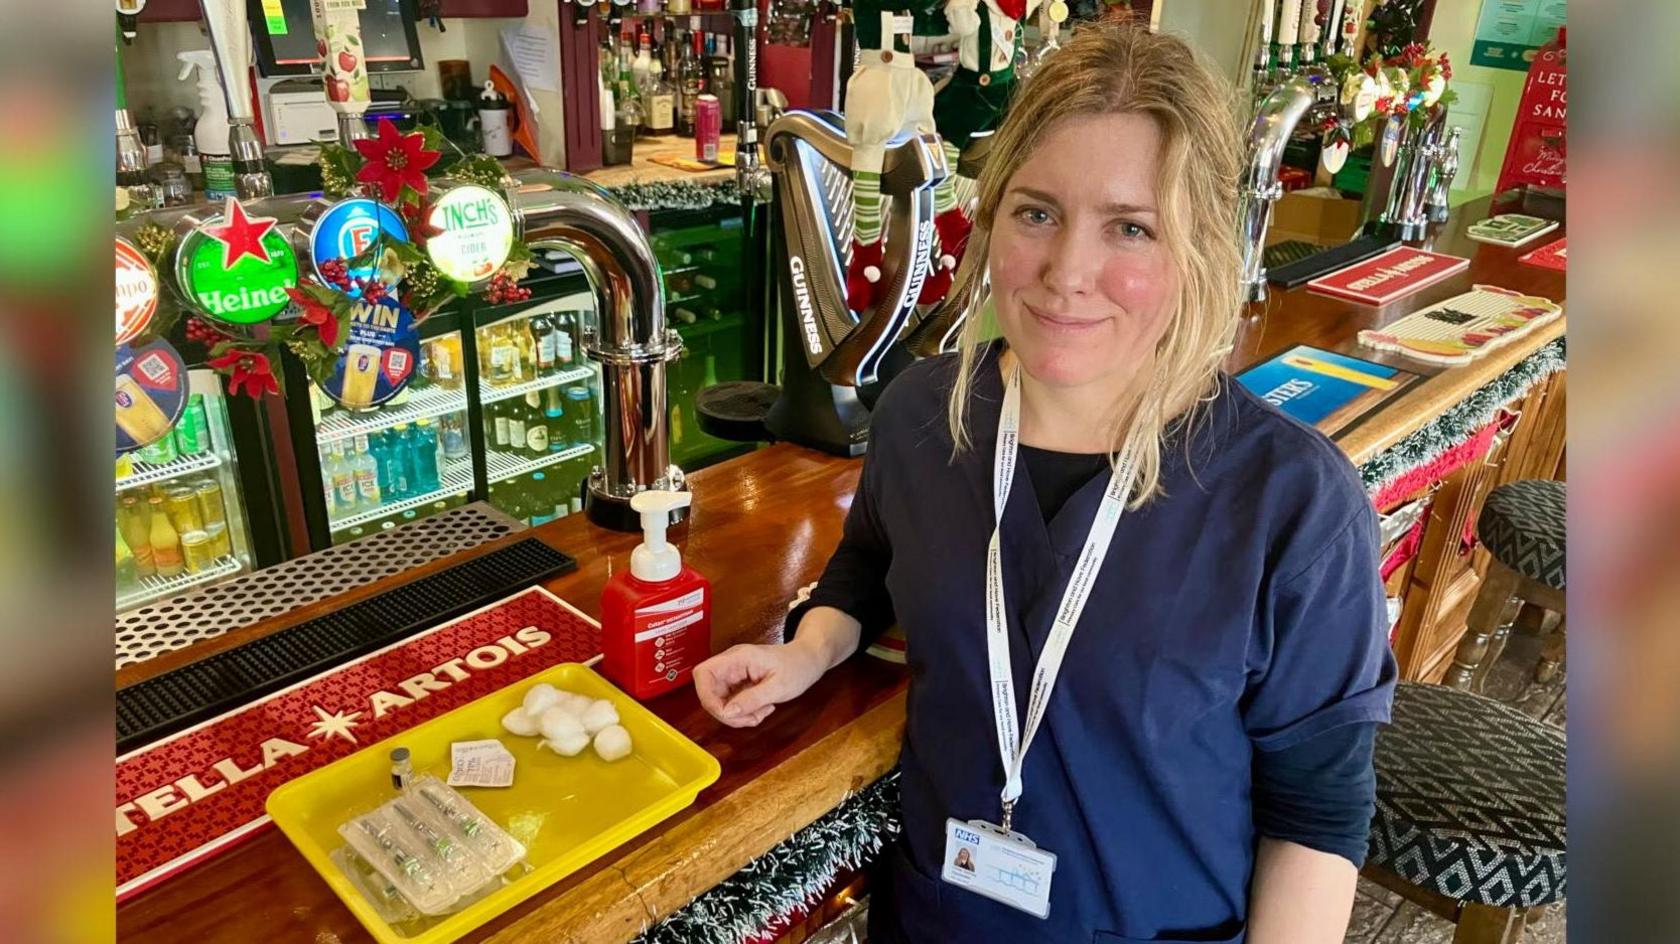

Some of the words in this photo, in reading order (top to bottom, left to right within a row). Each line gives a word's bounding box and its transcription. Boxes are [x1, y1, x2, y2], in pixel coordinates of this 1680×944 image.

[747, 38, 757, 91] GUINNESS
[443, 198, 498, 231] INCH'S
[903, 220, 930, 308] GUINNESS
[350, 302, 400, 329] WIN
[790, 256, 822, 354] GUINNESS
[369, 625, 552, 719] ARTOIS
[954, 828, 980, 845] NHS
